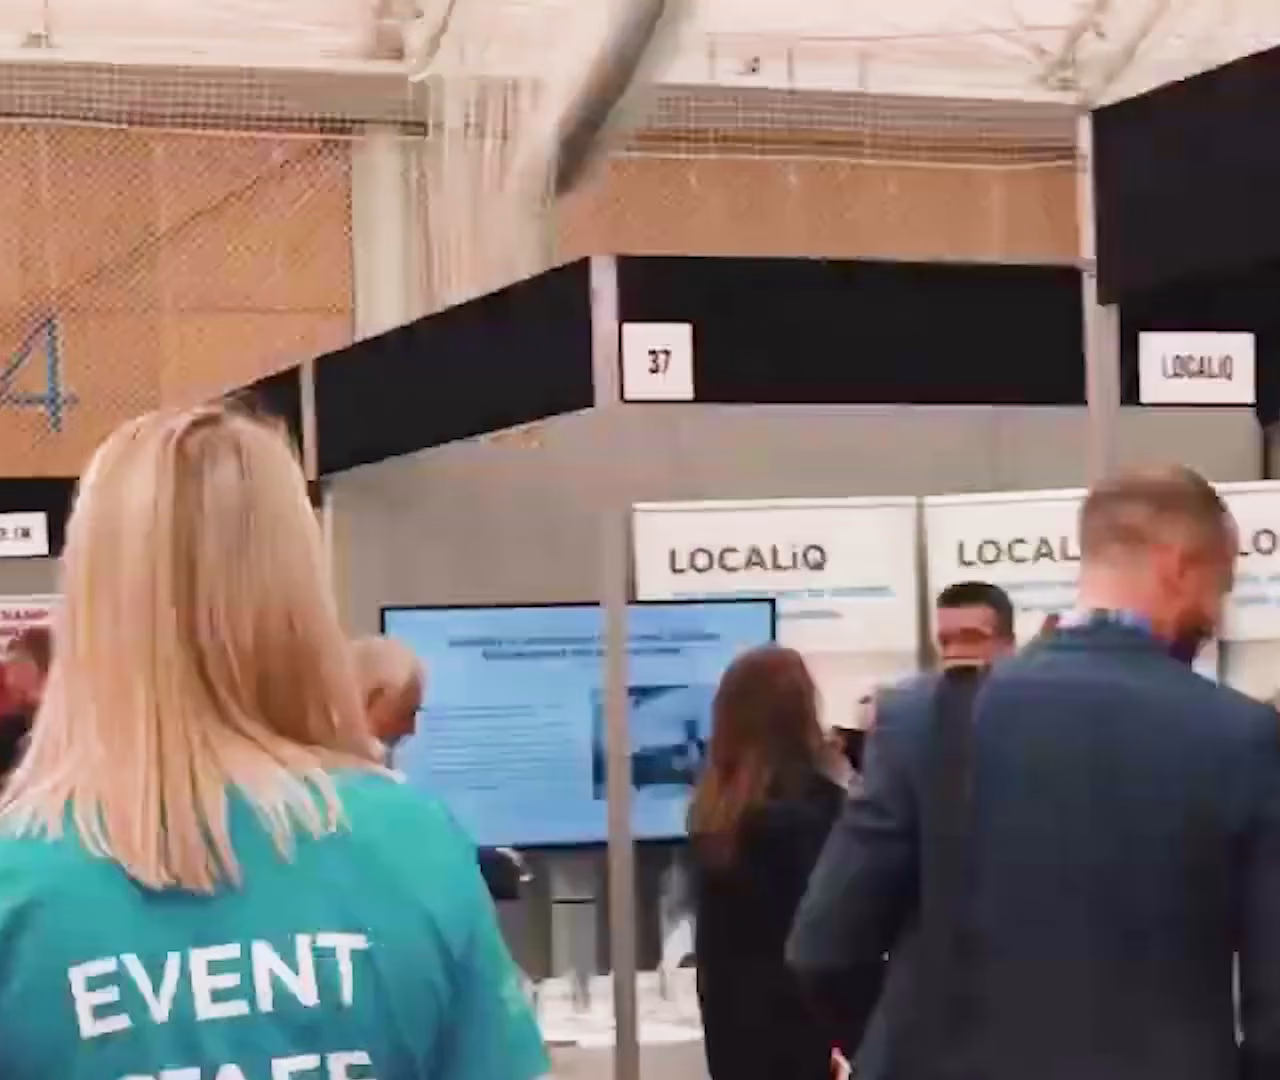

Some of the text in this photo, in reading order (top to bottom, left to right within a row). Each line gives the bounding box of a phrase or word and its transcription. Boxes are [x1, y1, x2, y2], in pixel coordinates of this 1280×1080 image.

[647, 348, 672, 374] 37
[958, 535, 1081, 568] LOCAL
[67, 931, 370, 1040] EVENT
